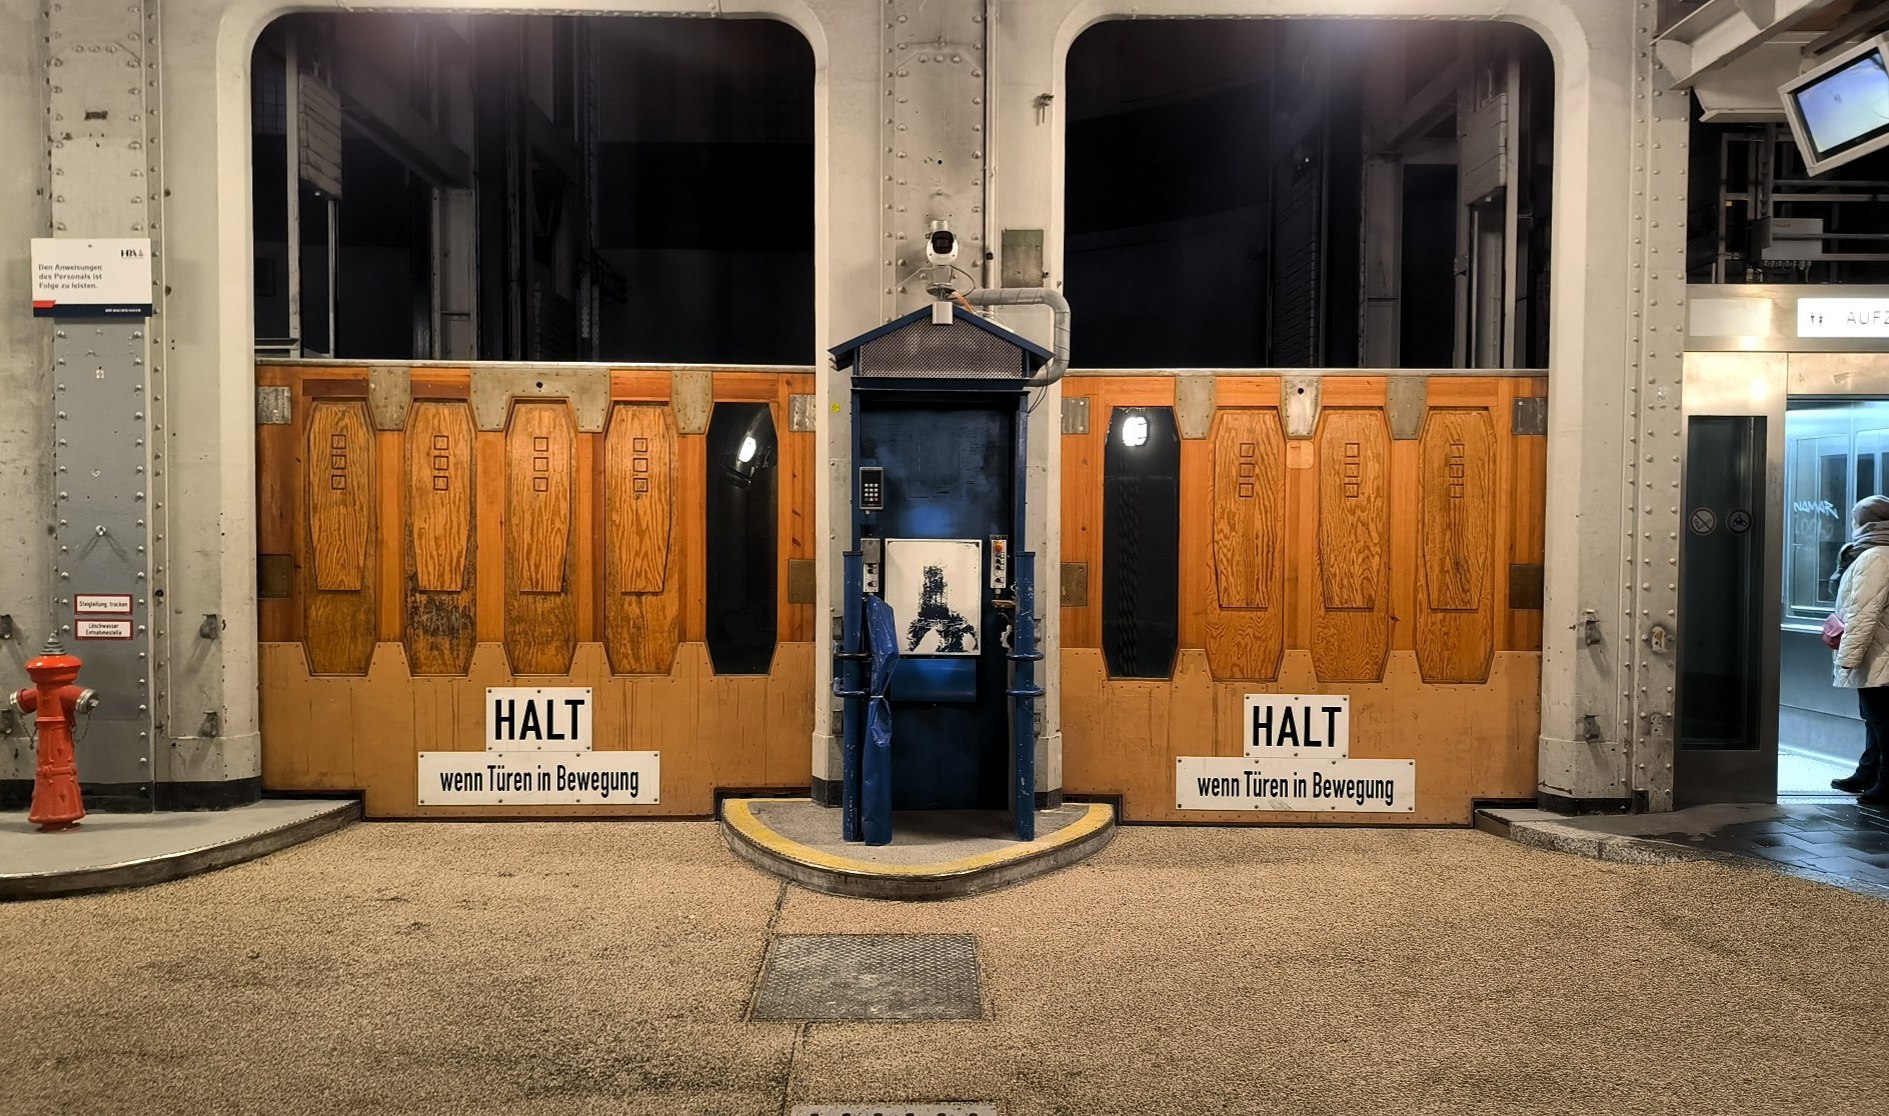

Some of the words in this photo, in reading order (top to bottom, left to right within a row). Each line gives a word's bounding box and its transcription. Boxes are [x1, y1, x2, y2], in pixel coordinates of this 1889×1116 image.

[38, 263, 53, 271] Den
[54, 263, 102, 272] Anweisungen
[39, 282, 59, 290] Folge
[494, 698, 586, 741] HALT
[1252, 705, 1343, 748] HALT
[440, 771, 483, 792] wenn
[487, 764, 532, 792] Türen
[537, 764, 551, 792] in
[556, 764, 639, 799] Bewegung
[1197, 776, 1240, 797] wenn
[1243, 770, 1289, 798] Türen
[1293, 771, 1307, 798] in
[1312, 771, 1395, 807] Bewegung
